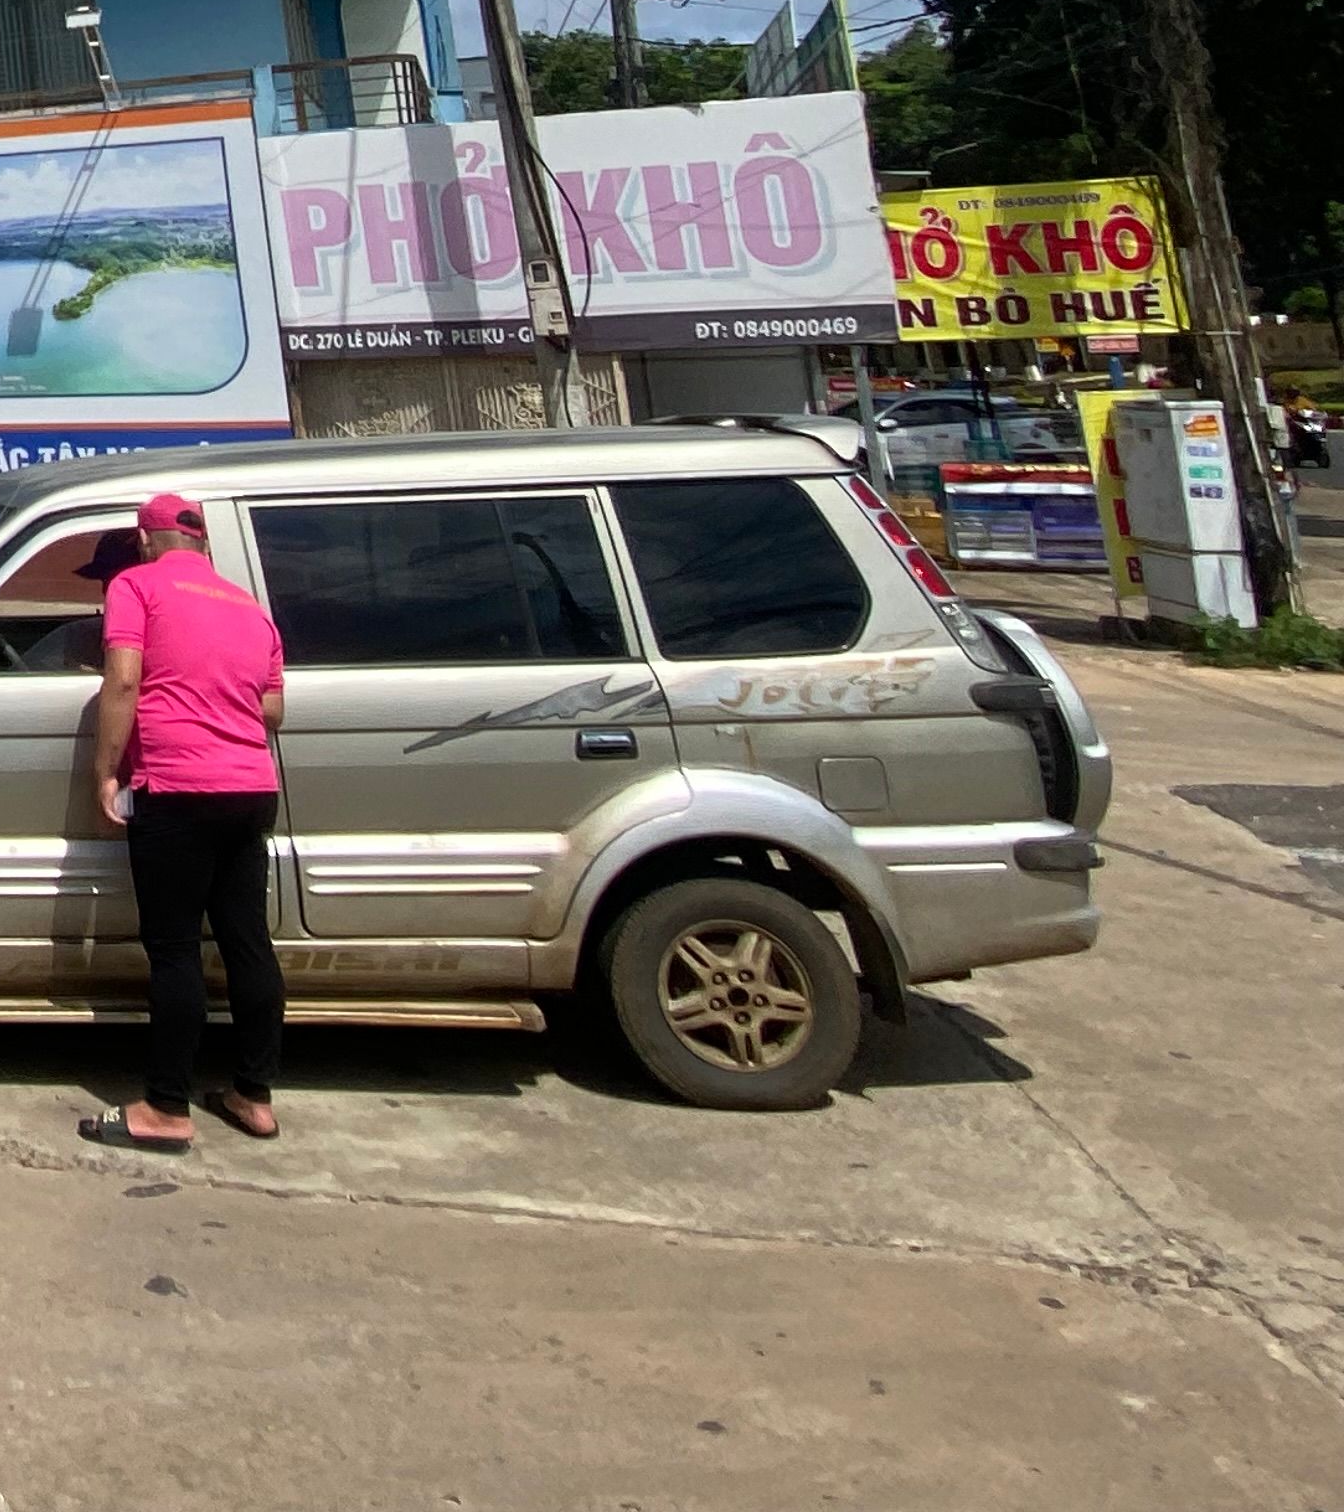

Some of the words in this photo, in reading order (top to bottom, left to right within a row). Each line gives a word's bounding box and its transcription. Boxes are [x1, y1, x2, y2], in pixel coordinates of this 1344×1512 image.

[279, 140, 522, 287] PHỞ
[556, 132, 823, 275] KHÔ
[985, 203, 1155, 277] KHÔ
[1049, 278, 1166, 323] HUẾ
[316, 332, 344, 350] 270
[346, 328, 363, 348] LÊ
[451, 327, 505, 346] PLEIKU
[518, 326, 535, 343] GI
[695, 321, 729, 339] ĐT:
[734, 316, 858, 337] 0849000469
